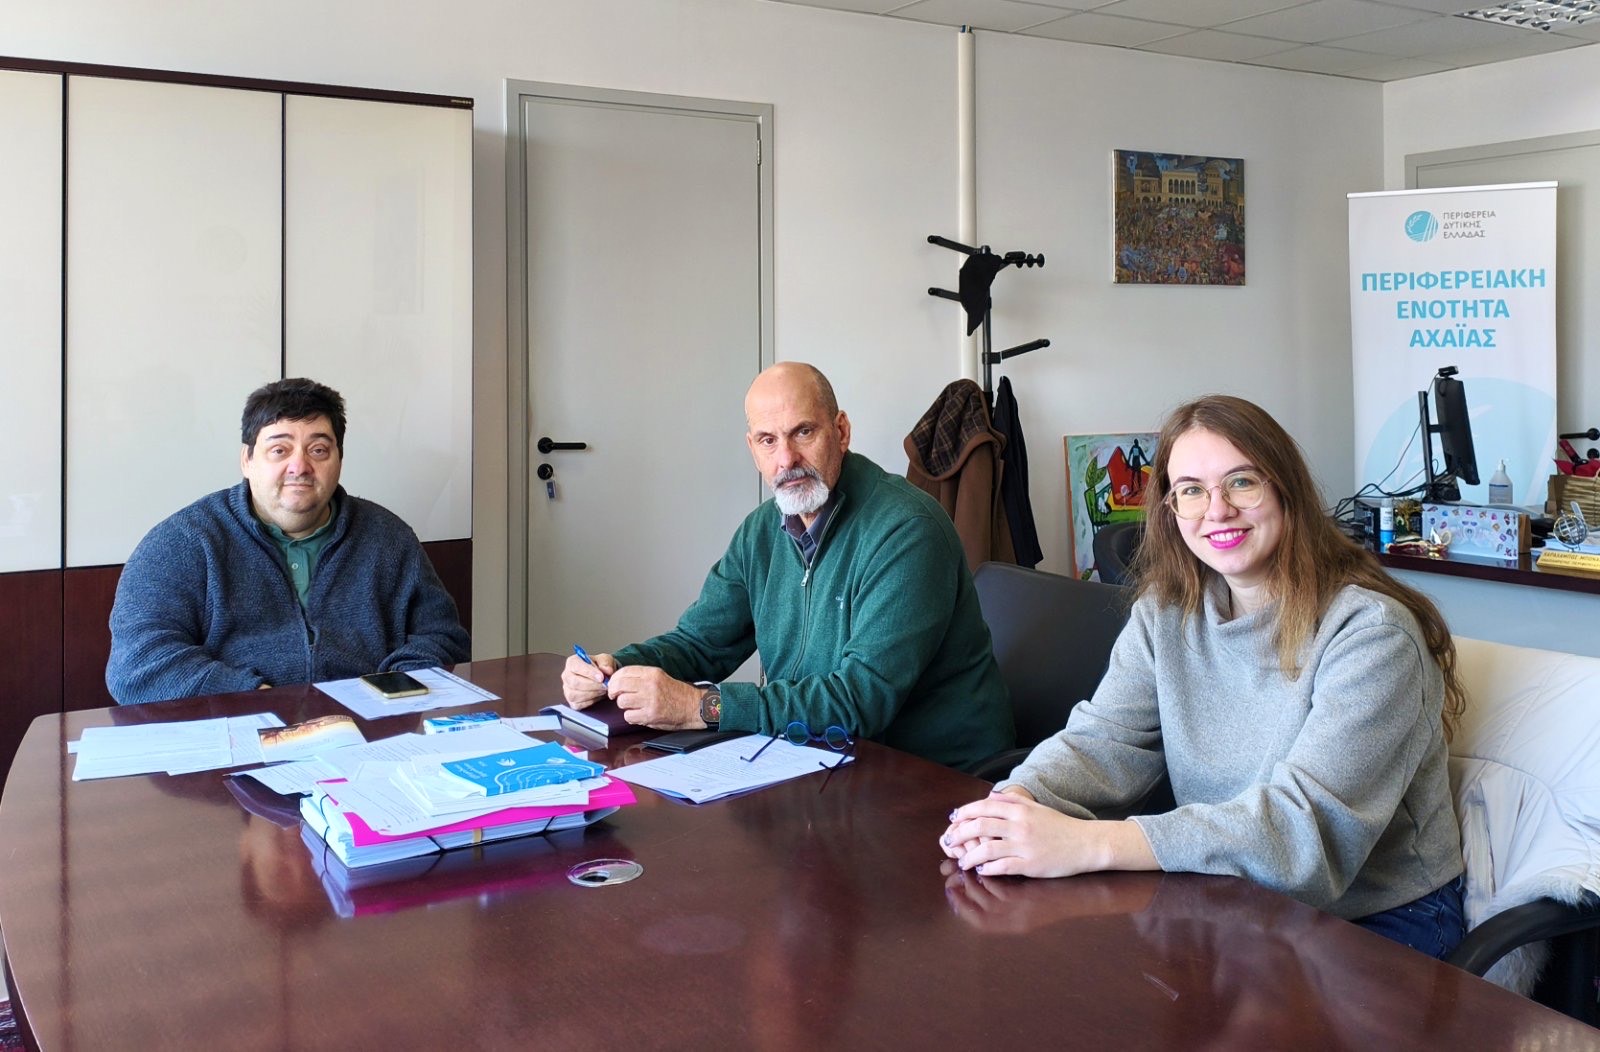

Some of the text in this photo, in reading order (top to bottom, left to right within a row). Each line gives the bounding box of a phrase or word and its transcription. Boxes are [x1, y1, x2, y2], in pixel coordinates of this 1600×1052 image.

[1443, 211, 1496, 220] ΠΕΡΙΦΕΡΕΙΑ
[1443, 221, 1481, 229] ΔΥΤΙΚΗΣ
[1443, 230, 1486, 239] ΕΛΛΑΔΑΣ
[1362, 269, 1546, 292] ΠΕΡΙΦΕΡΕΙΑΚΗ
[1397, 299, 1510, 320] ΕΝΟΤΗΤΑ
[1410, 323, 1496, 348] ΑΧΑΪΑΣ
